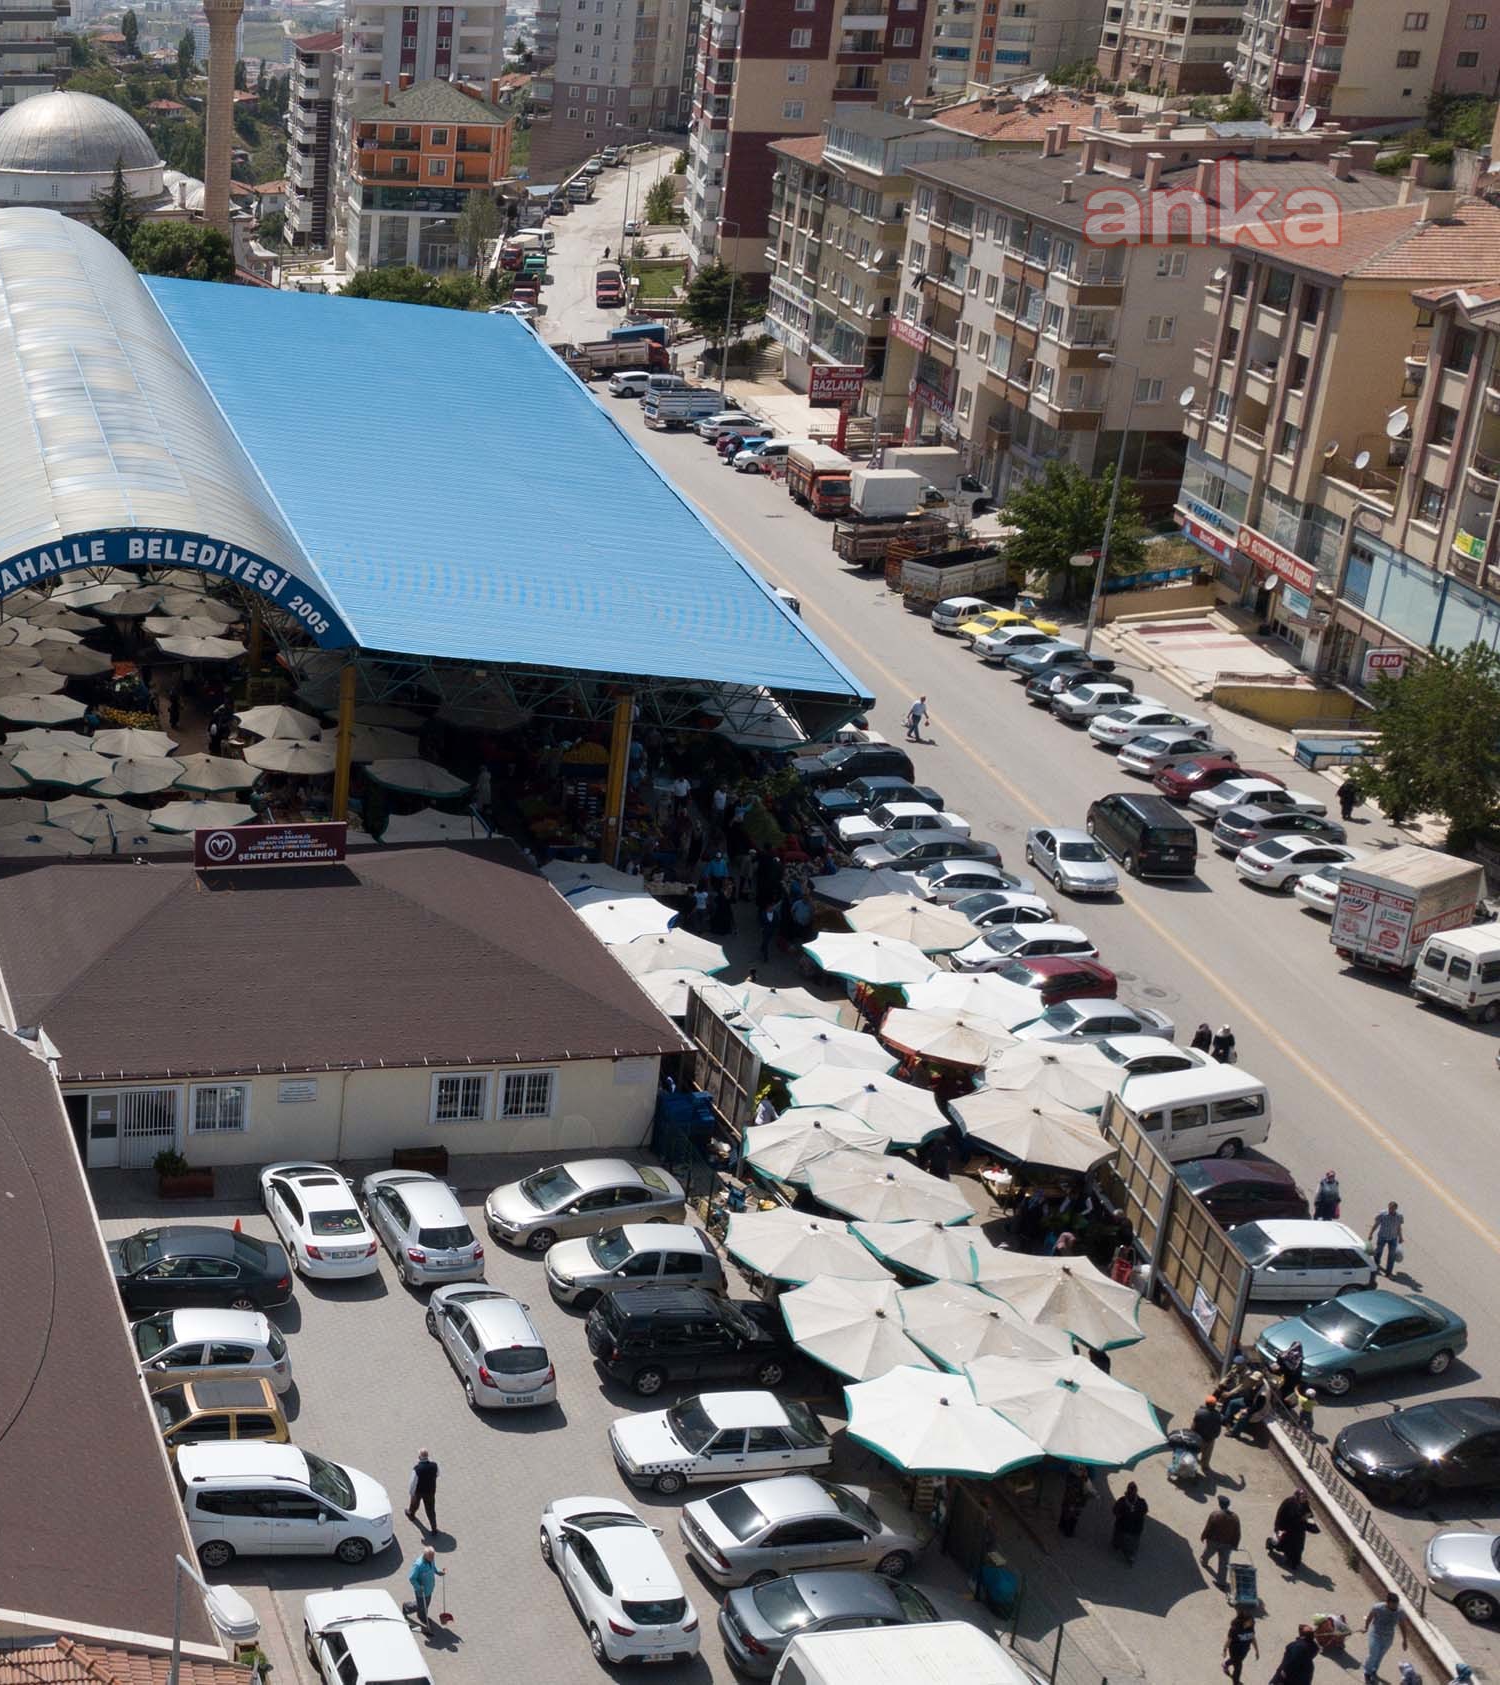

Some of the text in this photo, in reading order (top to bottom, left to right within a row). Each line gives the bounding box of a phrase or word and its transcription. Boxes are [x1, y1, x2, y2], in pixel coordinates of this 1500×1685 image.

[812, 379, 861, 392] BAZLAMA
[128, 537, 293, 598] BELEDİYESİ
[286, 593, 331, 636] 2005
[238, 849, 337, 862] ŞENTEPE POLİKLİNİĞİ
